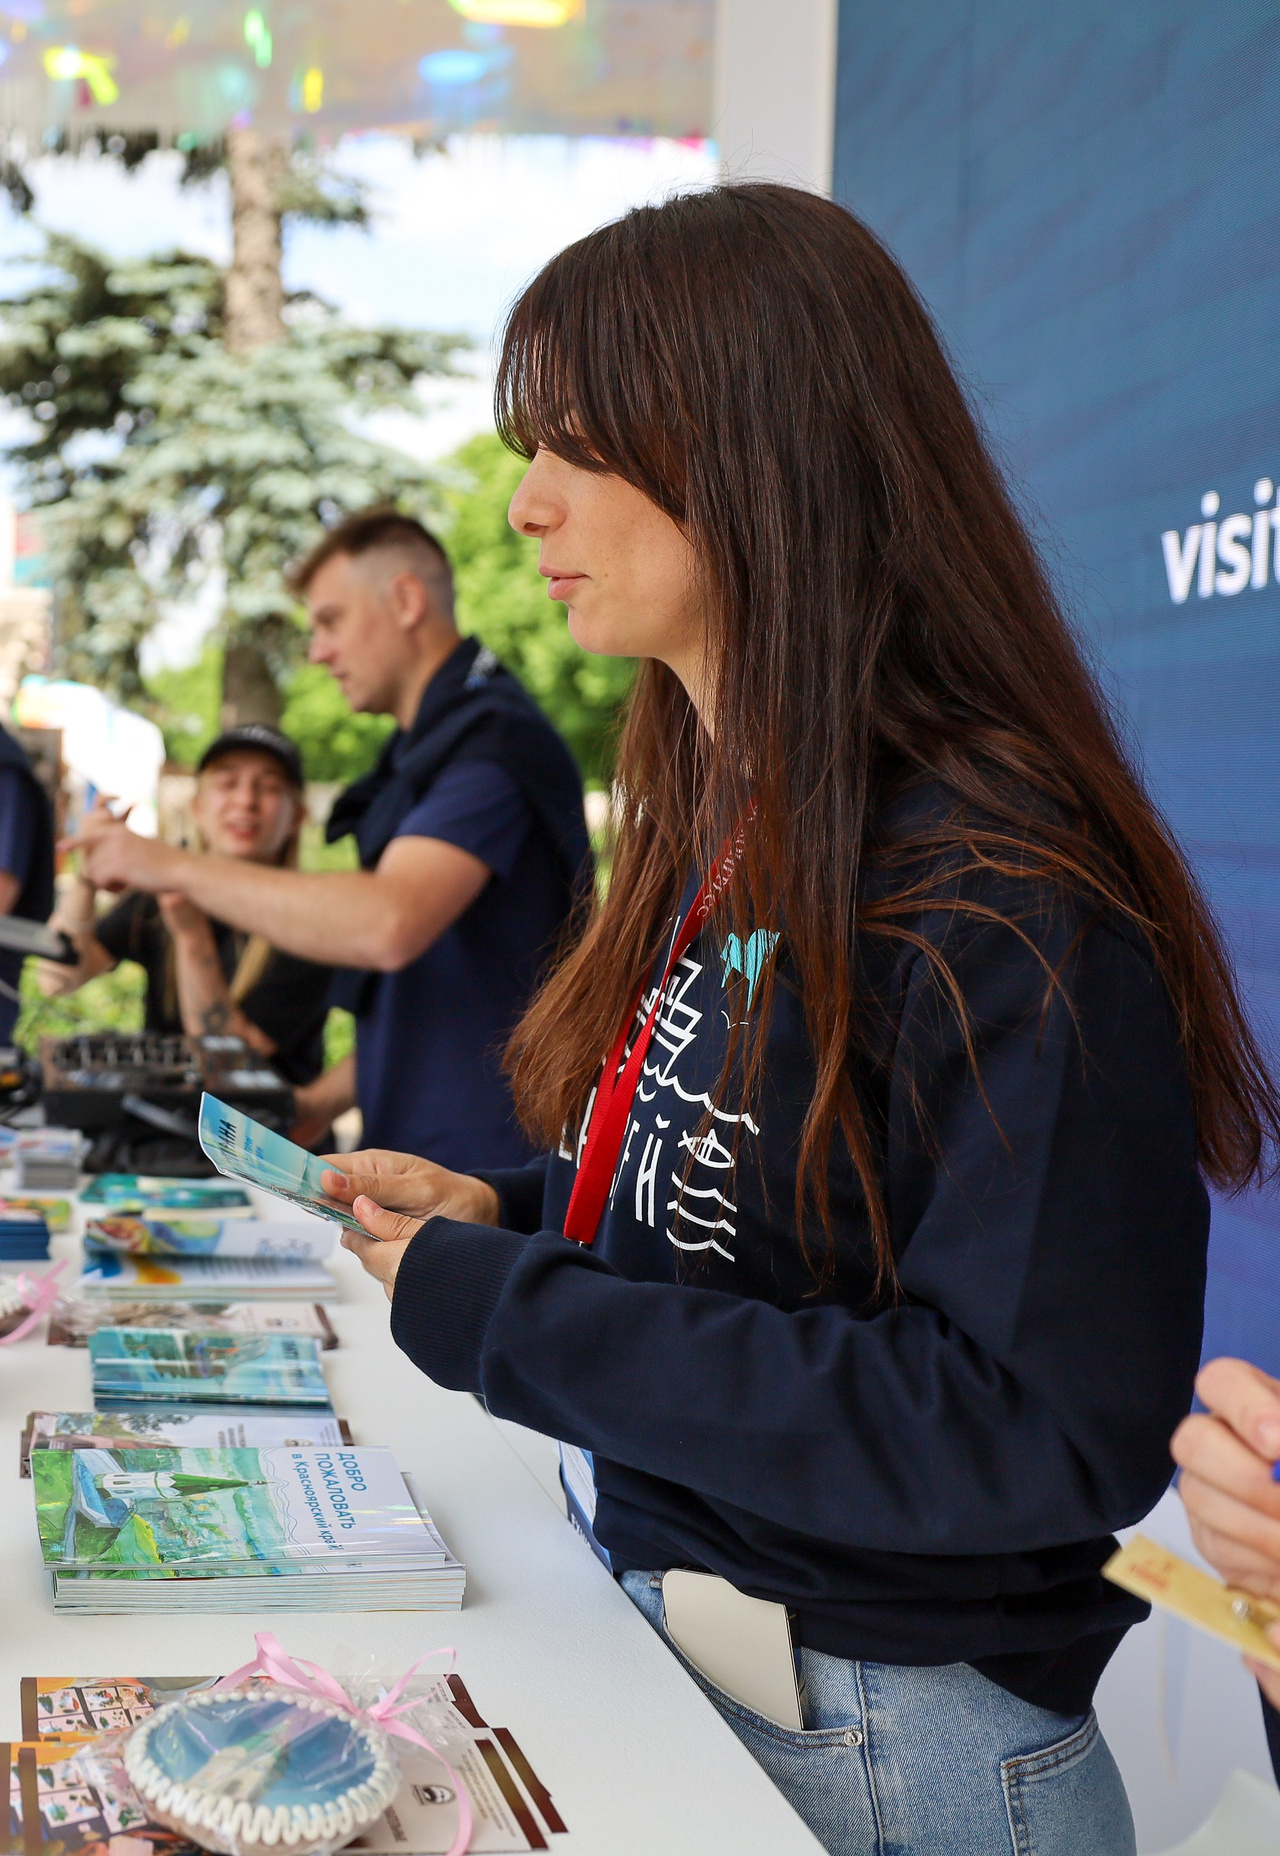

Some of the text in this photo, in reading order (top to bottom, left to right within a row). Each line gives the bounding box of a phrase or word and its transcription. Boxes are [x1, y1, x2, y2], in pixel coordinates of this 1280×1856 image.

[293, 1461, 333, 1529] Красноярский
[314, 1453, 356, 1530] ПОЖАЛОВАТЬ
[335, 1452, 367, 1492] ДОБРО
